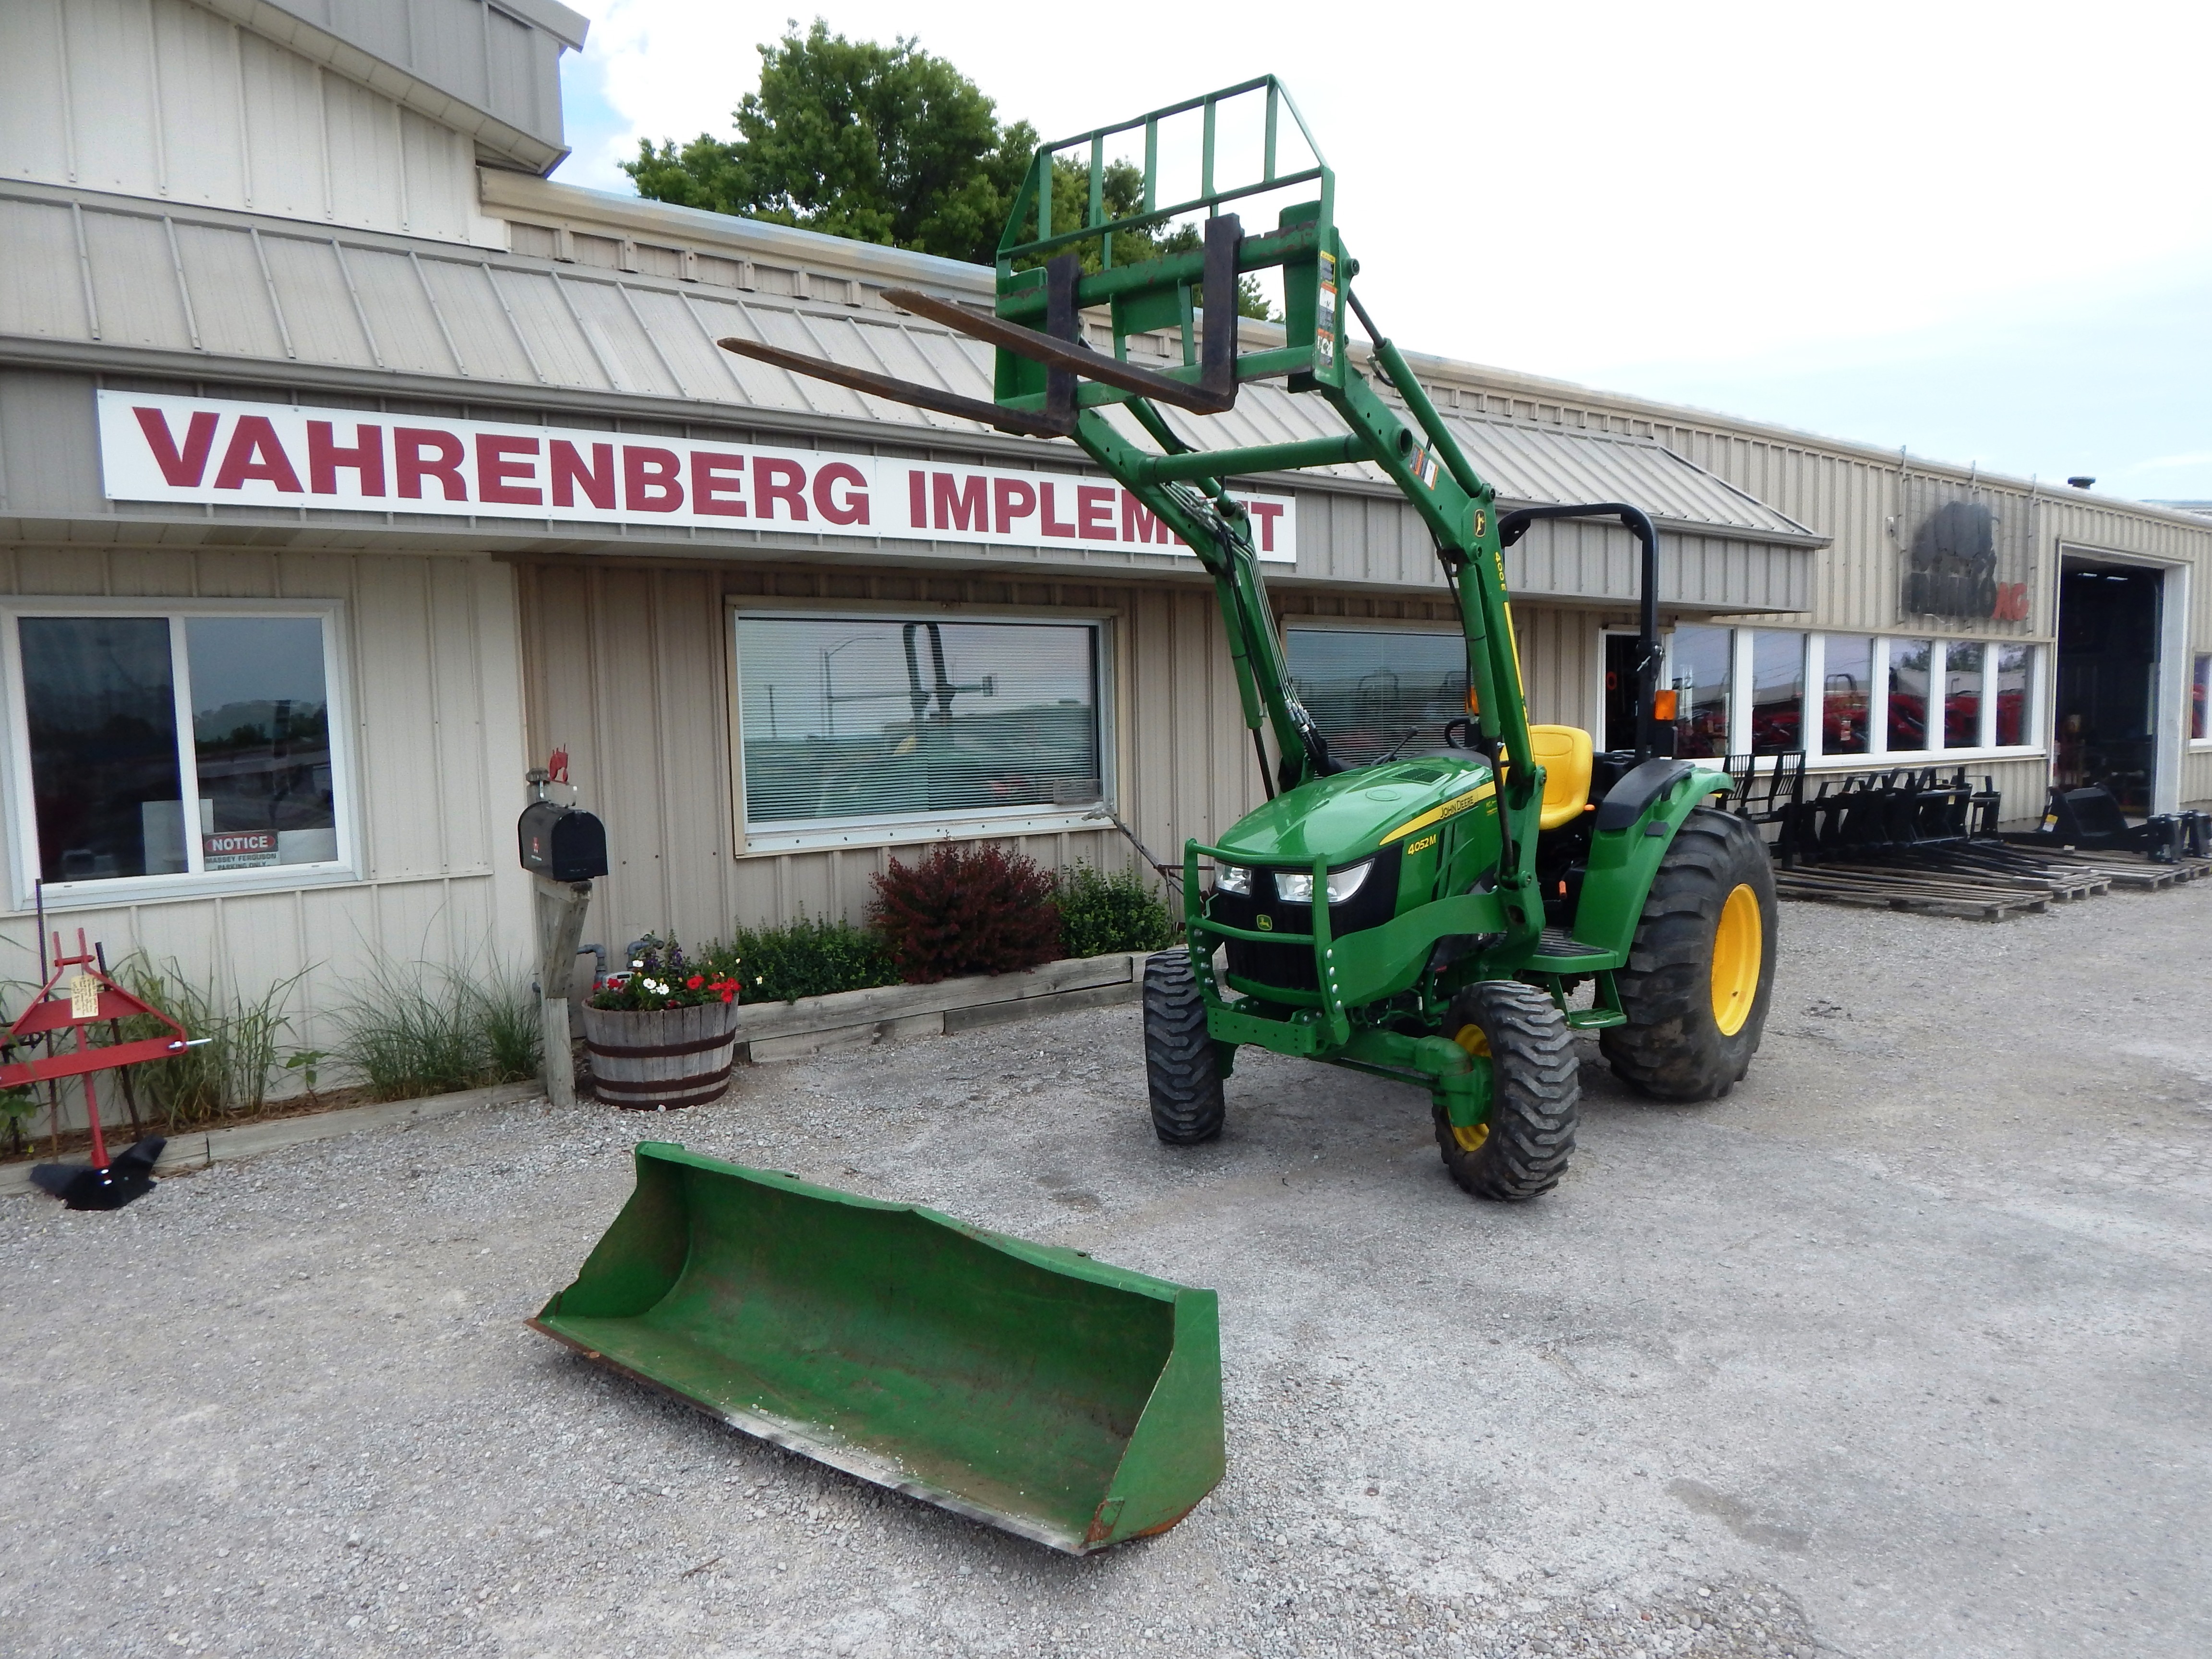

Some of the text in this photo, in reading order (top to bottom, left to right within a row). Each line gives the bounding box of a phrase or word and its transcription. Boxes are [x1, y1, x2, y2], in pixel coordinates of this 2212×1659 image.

[131, 406, 1284, 552] VAHRENBERG IMPLEMT
[1439, 802, 1457, 819] JOHN
[1456, 795, 1475, 811] DEERE
[212, 835, 269, 852] NOTICE
[1407, 834, 1437, 855] 4052M
